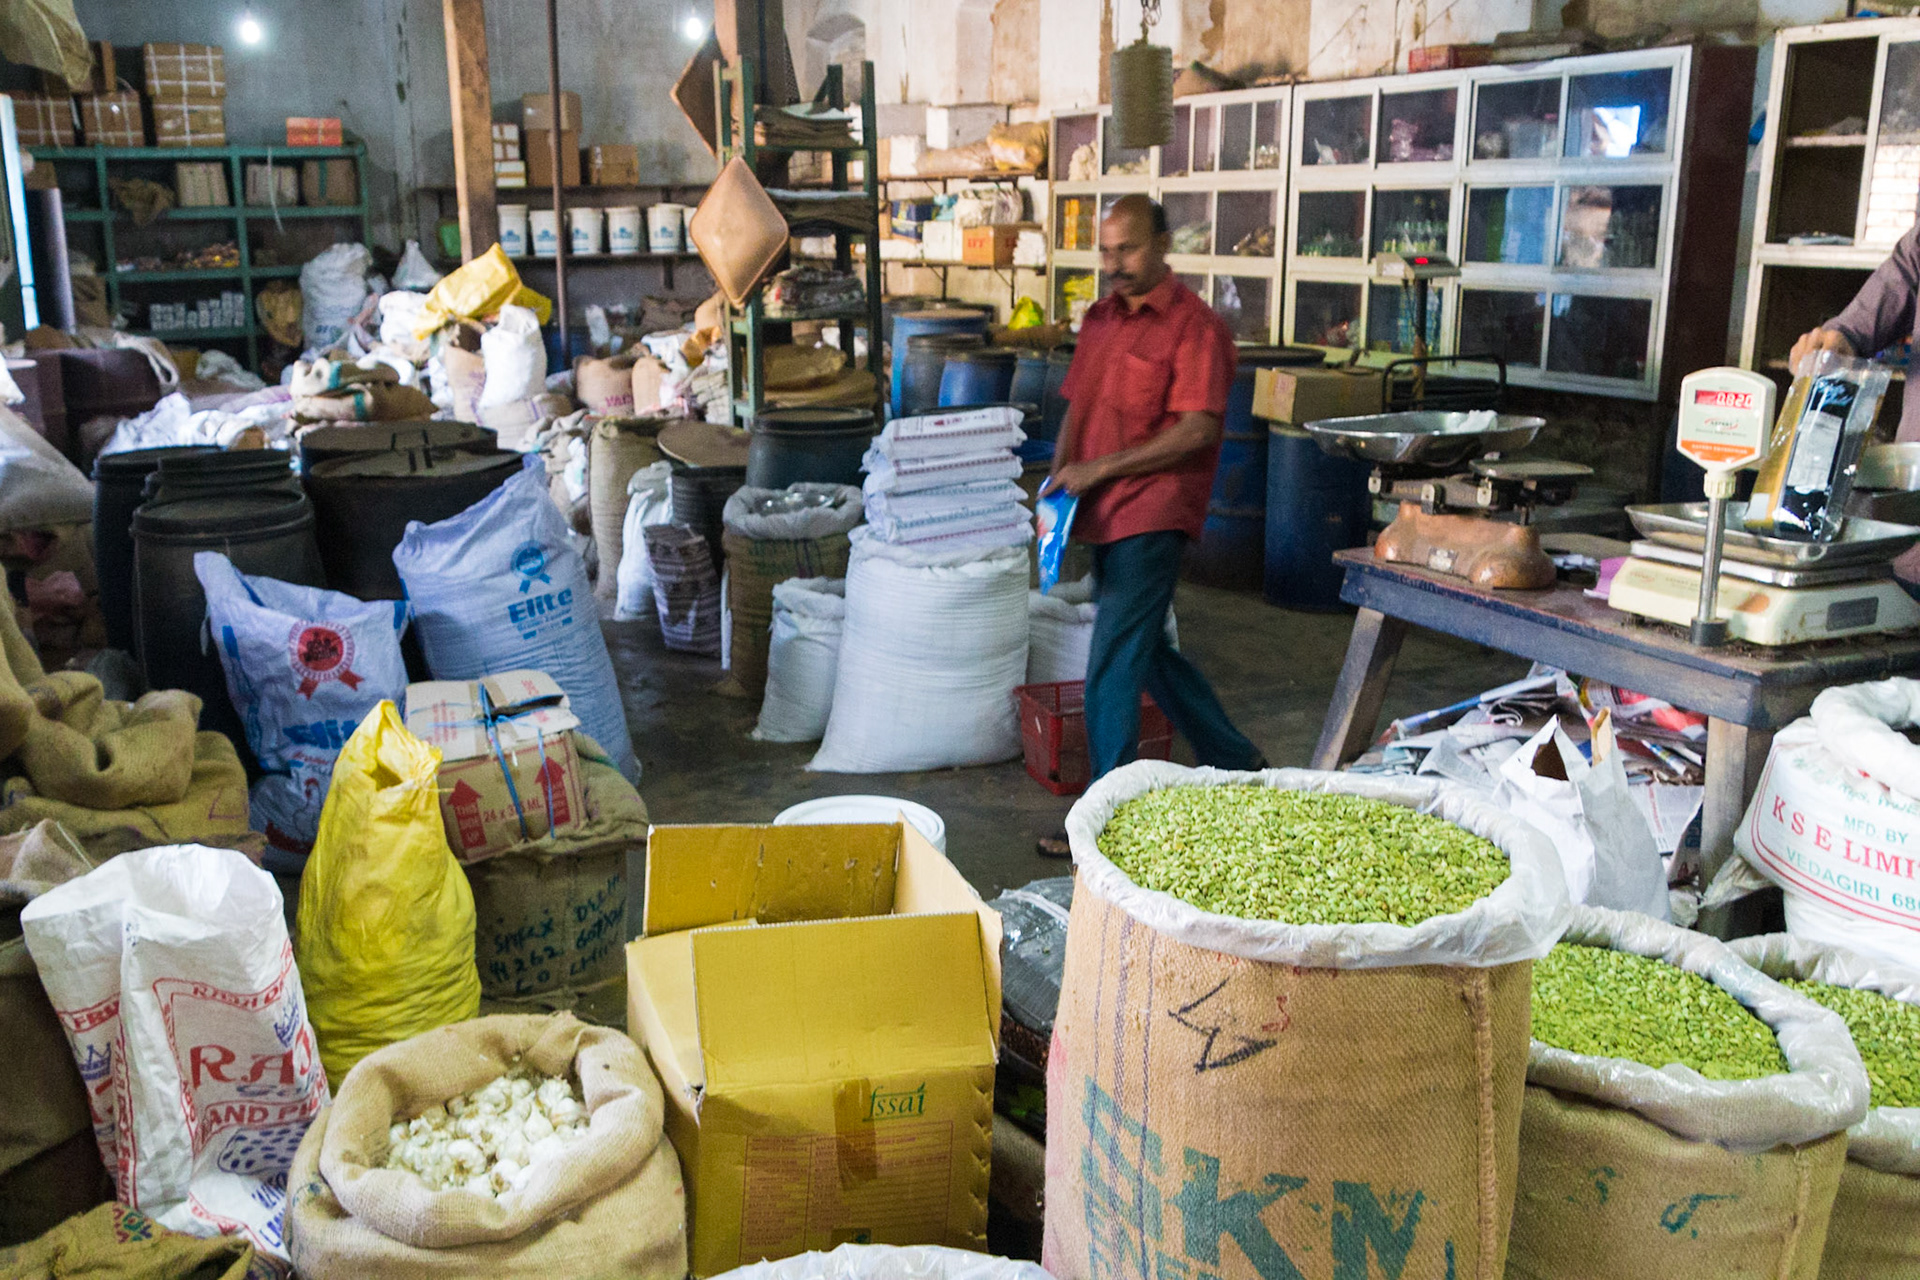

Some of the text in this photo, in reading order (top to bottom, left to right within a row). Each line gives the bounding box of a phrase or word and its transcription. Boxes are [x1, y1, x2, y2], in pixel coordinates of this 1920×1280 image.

[508, 588, 574, 624] Elite
[1885, 827, 1909, 846] BY
[1787, 847, 1880, 902] VEDAGIRI
[1842, 838, 1920, 881] LIMI
